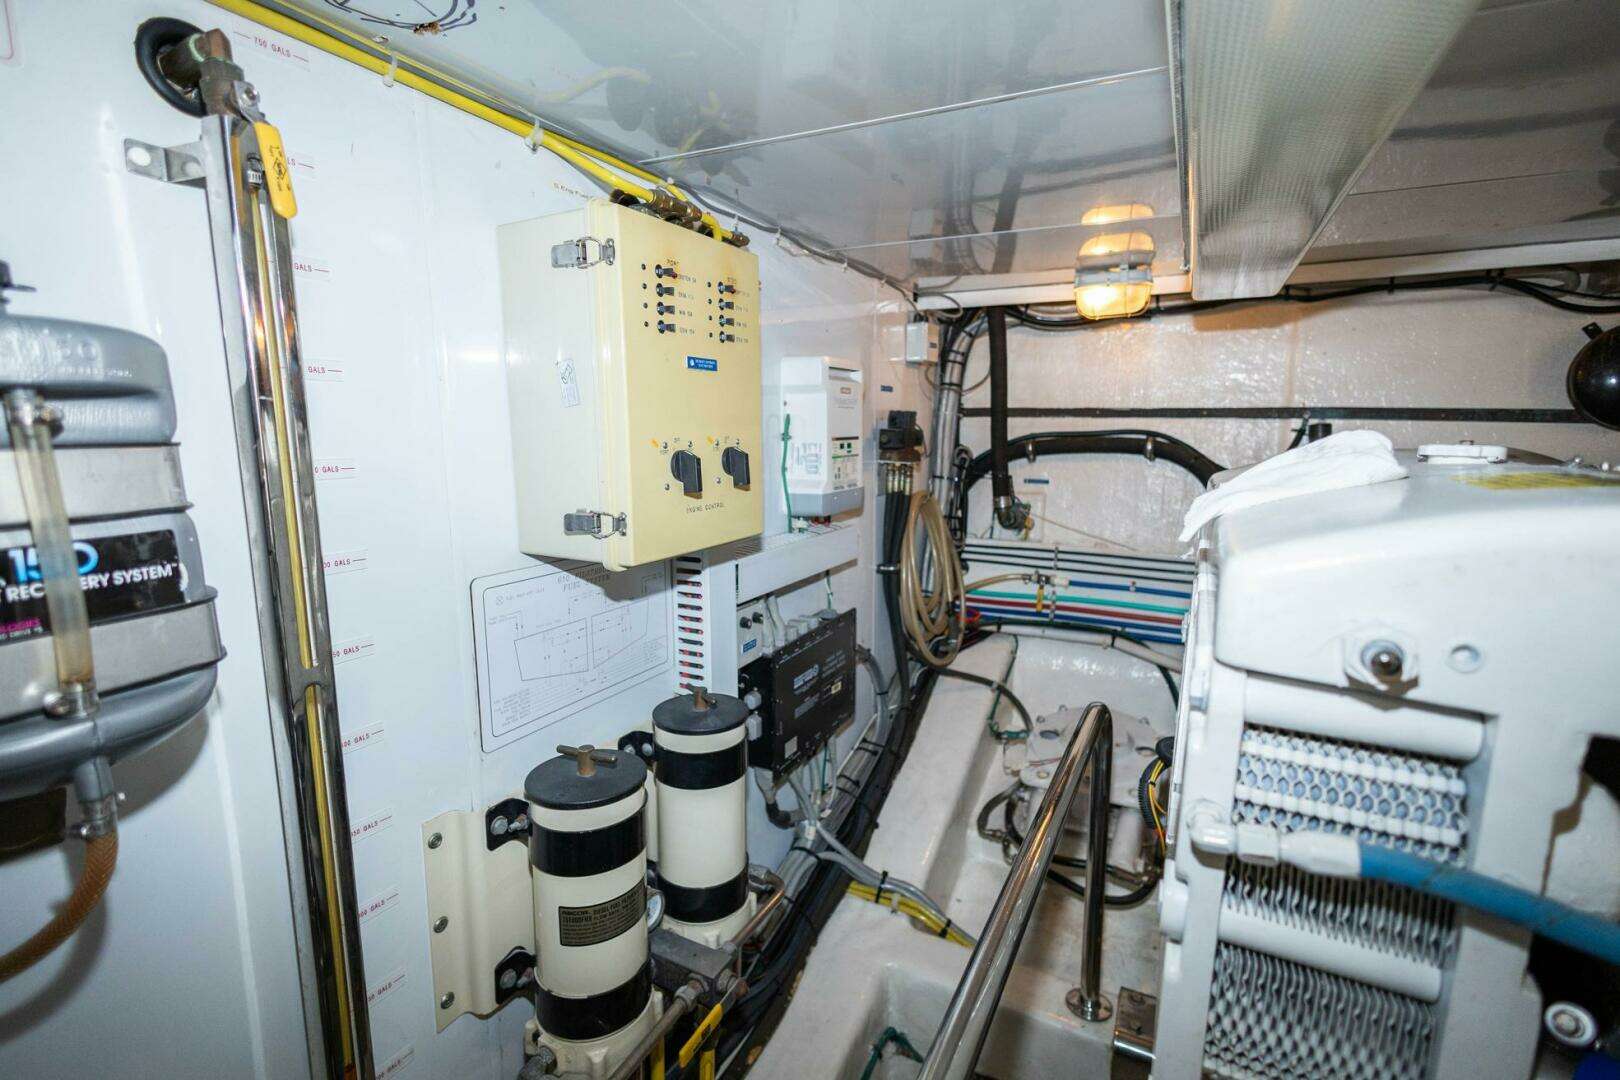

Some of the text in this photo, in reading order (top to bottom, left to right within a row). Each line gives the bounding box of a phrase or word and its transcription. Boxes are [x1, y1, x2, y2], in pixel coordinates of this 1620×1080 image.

[271, 43, 291, 58] GALS
[294, 262, 313, 273] GALS
[308, 366, 326, 374] GALS
[322, 465, 339, 473] GALS
[335, 558, 351, 567] GALS
[5, 571, 110, 604] RECERY
[343, 646, 360, 655] GALS
[354, 732, 370, 744] GALS
[363, 820, 379, 832] GALS
[370, 899, 385, 912] GALS
